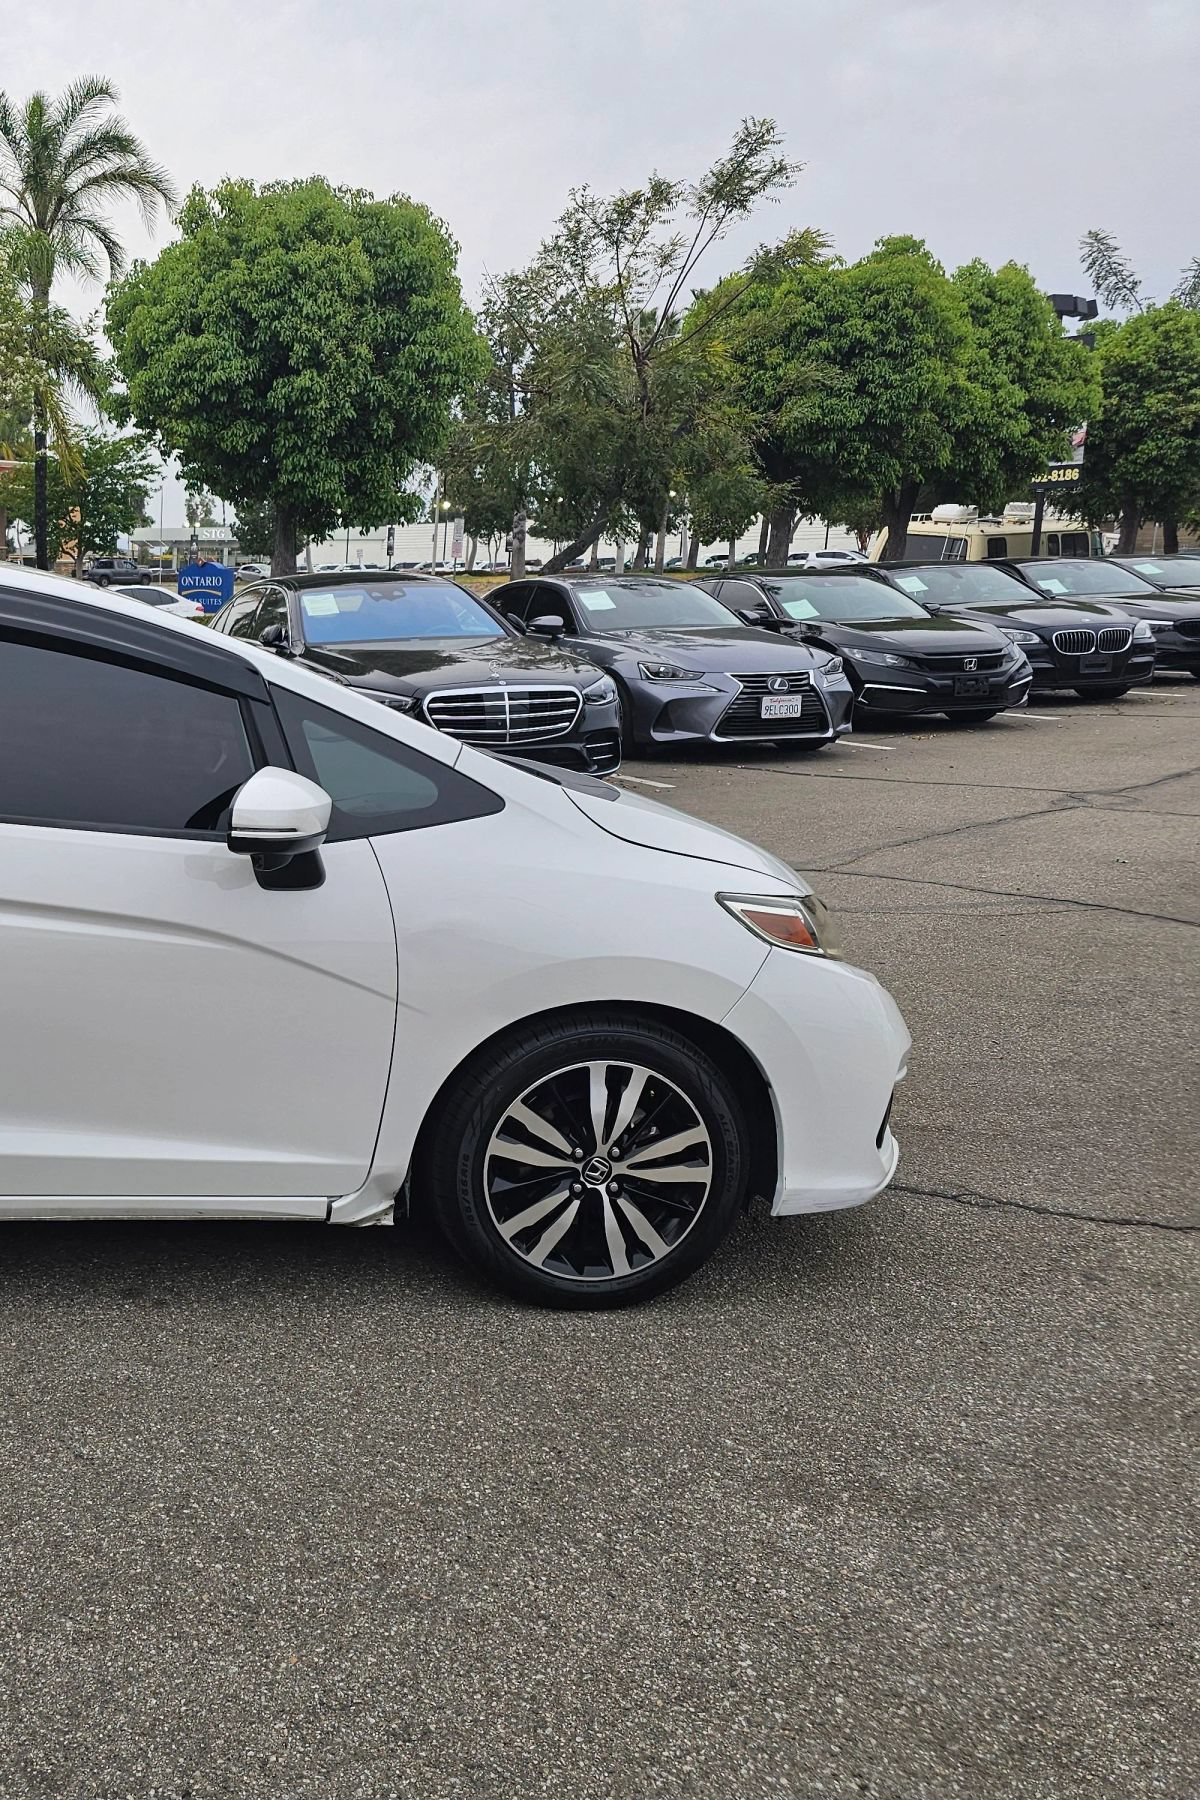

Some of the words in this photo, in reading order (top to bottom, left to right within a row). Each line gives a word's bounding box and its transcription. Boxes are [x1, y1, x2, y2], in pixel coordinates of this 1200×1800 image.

[202, 529, 225, 539] STG
[181, 576, 222, 586] ONTARIO
[764, 704, 799, 715] 9ELC300
